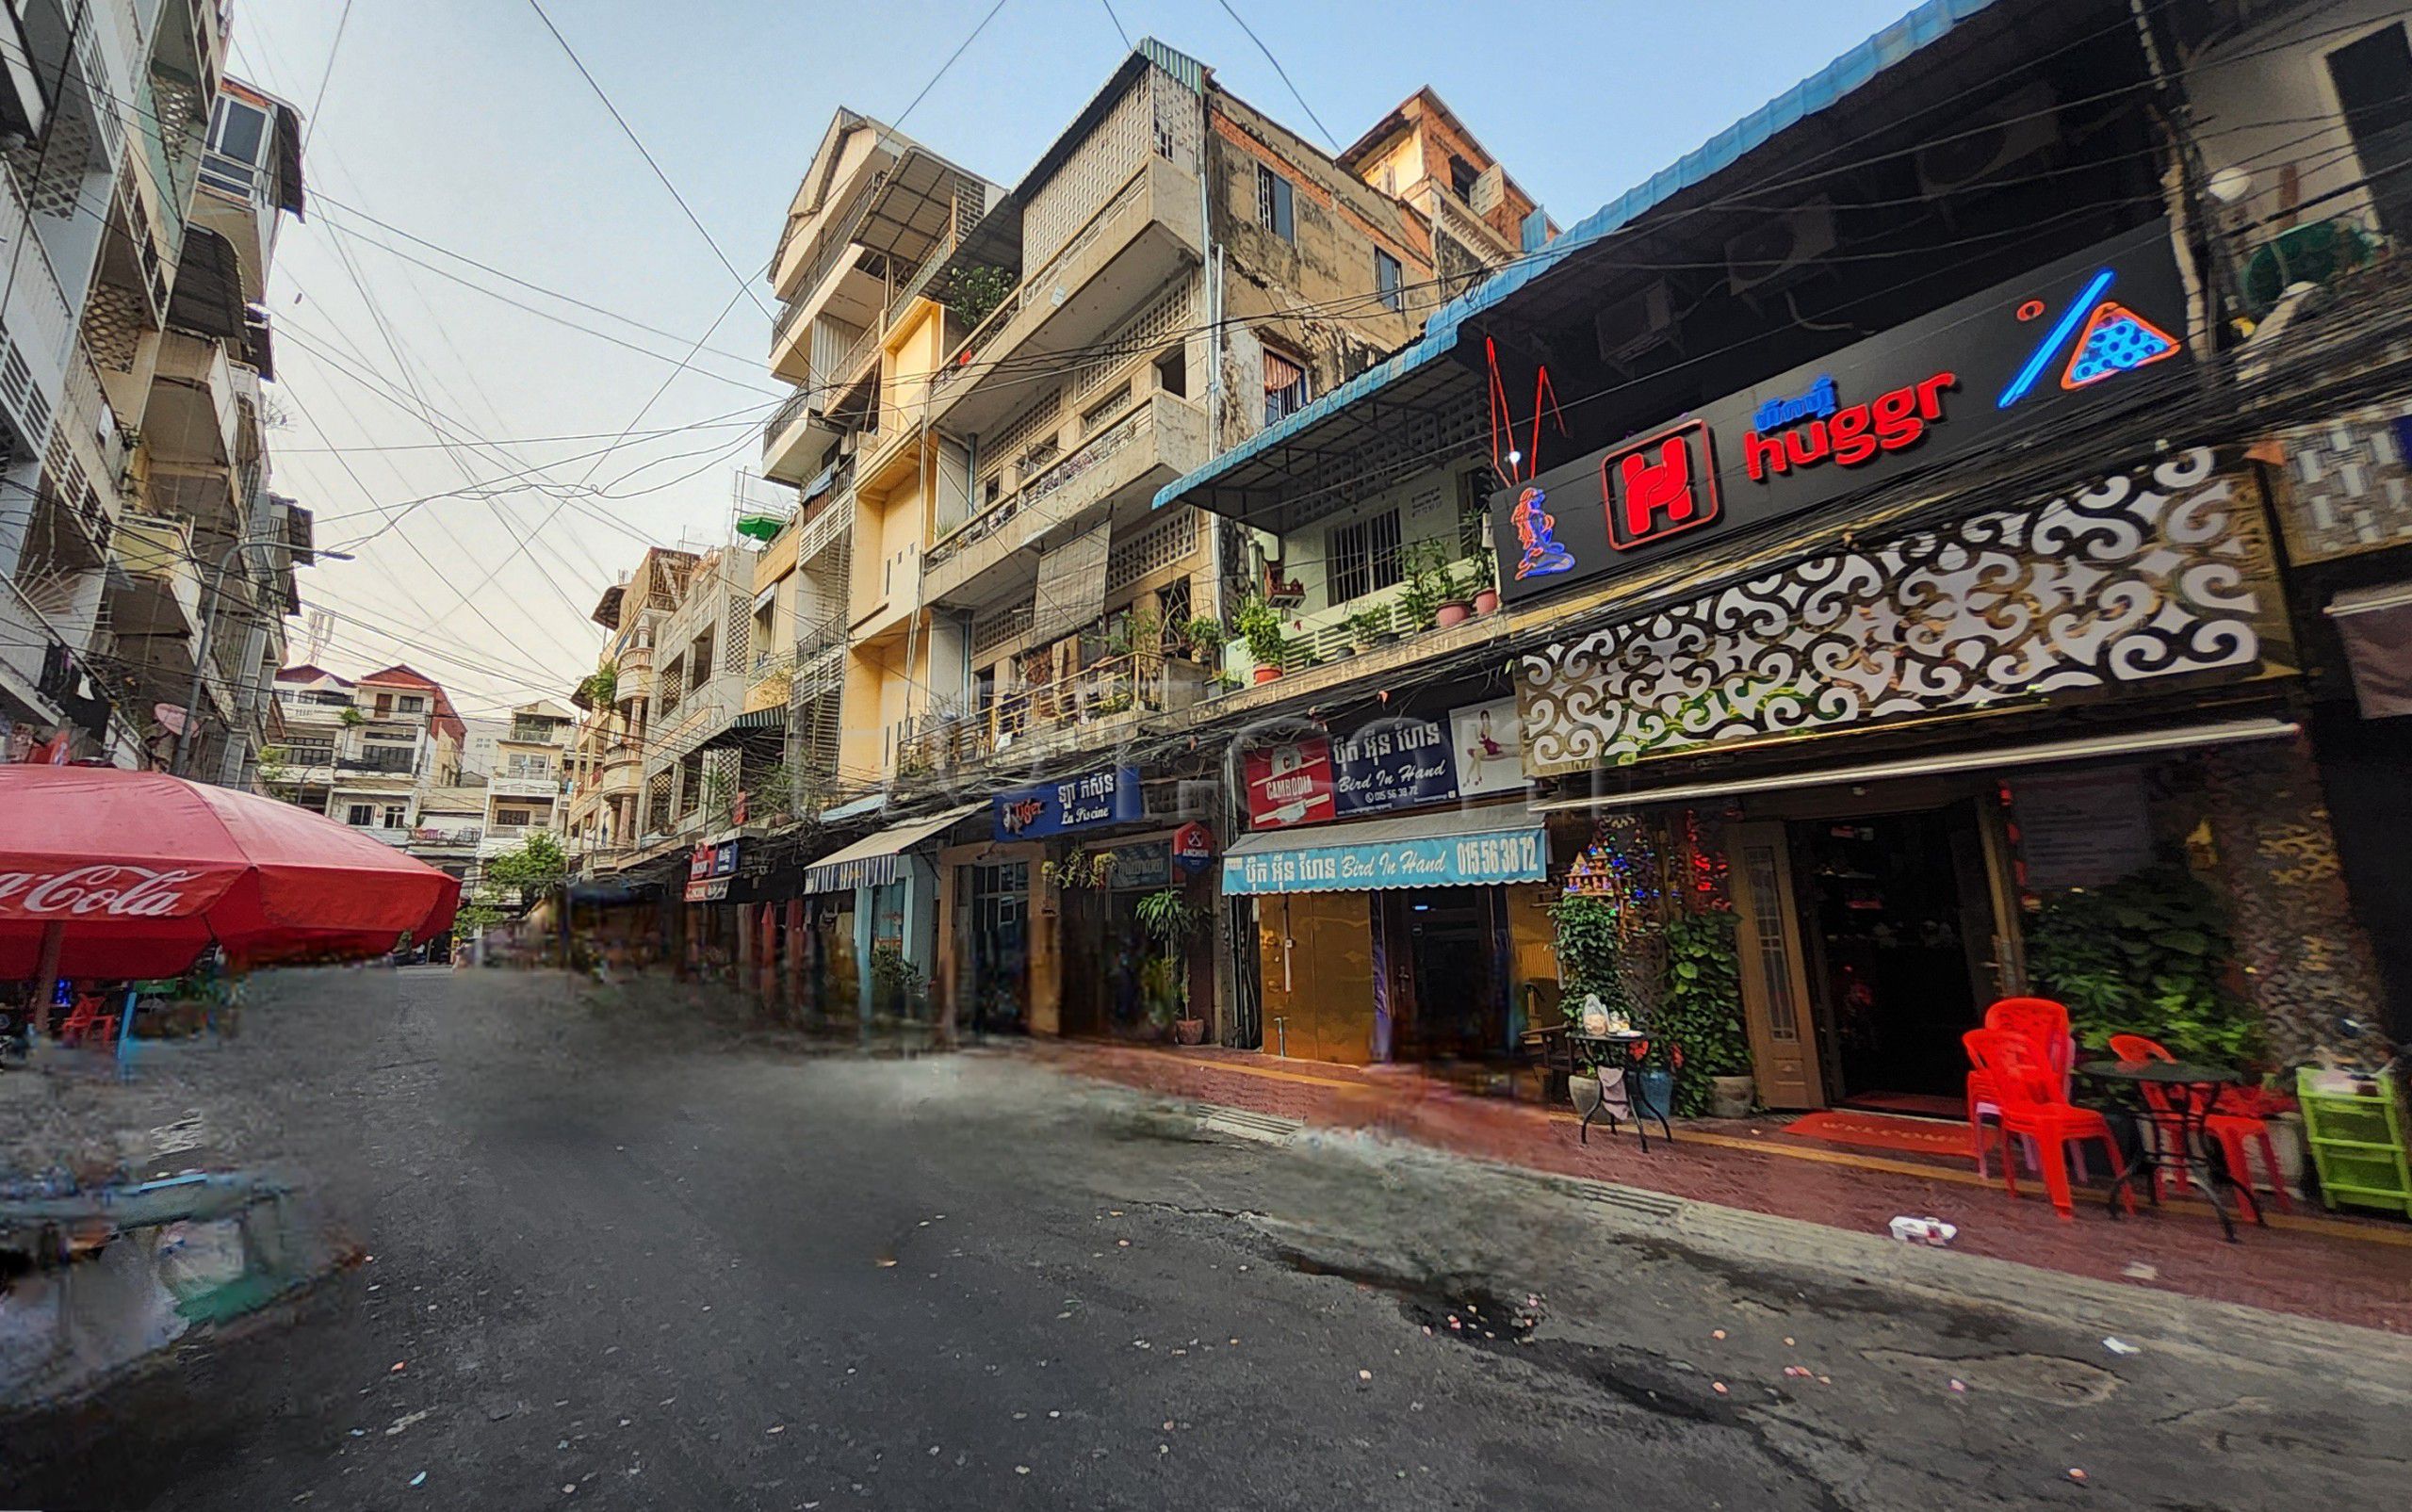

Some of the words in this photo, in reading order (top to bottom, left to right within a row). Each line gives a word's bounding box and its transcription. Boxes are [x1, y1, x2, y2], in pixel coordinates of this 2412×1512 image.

[1745, 372, 1956, 480] huggr
[1265, 774, 1314, 801] CAMBODIA
[1338, 773, 1373, 793] Bird
[1376, 770, 1394, 787] In
[1398, 759, 1446, 783] Hand
[1375, 790, 1386, 801] 015
[1015, 799, 1043, 824] Tiger
[1061, 811, 1074, 825] La
[1076, 806, 1110, 823] Piscine
[1341, 854, 1376, 879] Bird
[1378, 852, 1397, 876] In
[1399, 850, 1446, 874] Hand
[1457, 839, 1480, 876] 015
[1481, 838, 1499, 874] 56
[1501, 837, 1519, 872] 38
[1519, 836, 1539, 871] 72
